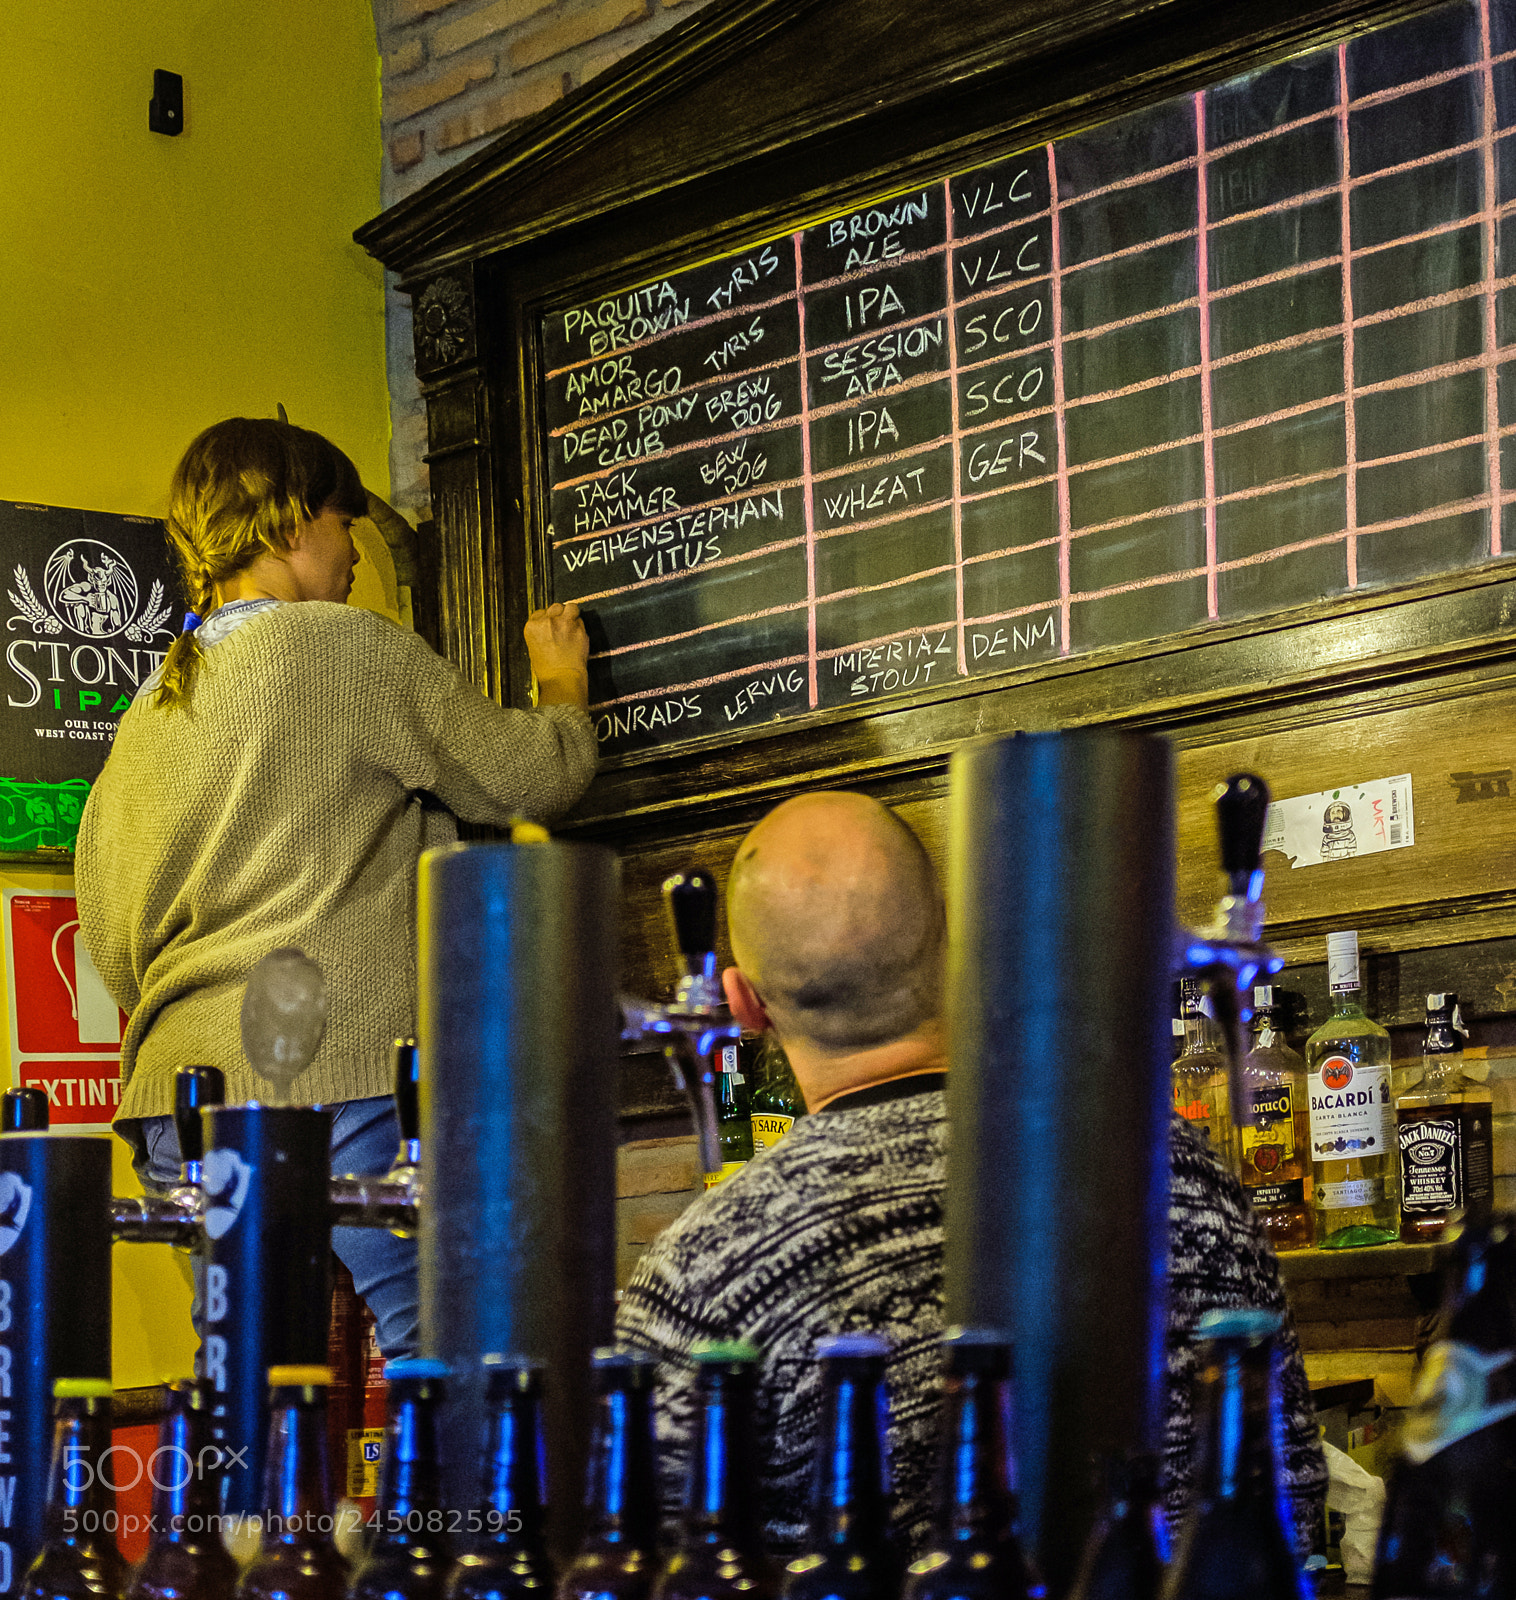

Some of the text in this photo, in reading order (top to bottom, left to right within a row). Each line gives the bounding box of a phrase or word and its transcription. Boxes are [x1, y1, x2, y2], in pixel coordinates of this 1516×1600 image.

[962, 169, 1032, 219] VLC
[827, 192, 928, 248] BROWN
[844, 230, 905, 272] ALE
[960, 234, 1041, 287] VLC
[707, 246, 779, 310] TYRIS
[564, 281, 678, 343] PAQUITA
[589, 298, 690, 356] BROWN
[845, 284, 905, 330] IPA
[965, 299, 1042, 354] SCO
[703, 316, 765, 371] TYRIS
[820, 320, 942, 383] SESSION
[565, 355, 637, 402] AMOR
[578, 366, 681, 417] AMARGO
[705, 377, 770, 423] BREW
[846, 362, 904, 398] APA
[965, 366, 1043, 417] SCO
[564, 393, 699, 463] DEAD PONY
[731, 393, 783, 431] DOG
[848, 406, 900, 455] IPA
[598, 430, 665, 466] CLUB
[700, 438, 748, 485] BEW
[968, 430, 1046, 483] GER
[574, 467, 637, 509] JACK
[725, 452, 768, 494] DOG
[823, 467, 926, 519] WHEAT
[562, 489, 784, 572] WEIHENSTEPHAN
[574, 486, 681, 534] HAMMER
[633, 535, 722, 580] VITUS
[833, 632, 952, 676] IMPERIAL
[971, 616, 1056, 660] DENM
[53, 688, 132, 713] IPA
[724, 669, 804, 721] LERVIG
[850, 661, 937, 696] STOUT
[34, 728, 65, 738] WEST
[69, 730, 105, 741] COAST
[64, 719, 90, 729] OUR
[1371, 799, 1387, 846] MKT
[1312, 1086, 1374, 1111] BACARDÍ
[1338, 1110, 1368, 1119] BLANCA
[758, 1119, 787, 1135] SARK
[1399, 1128, 1420, 1150] JACK
[1420, 1124, 1457, 1147] DANIEL'S
[1410, 1176, 1446, 1186] WHISKEY
